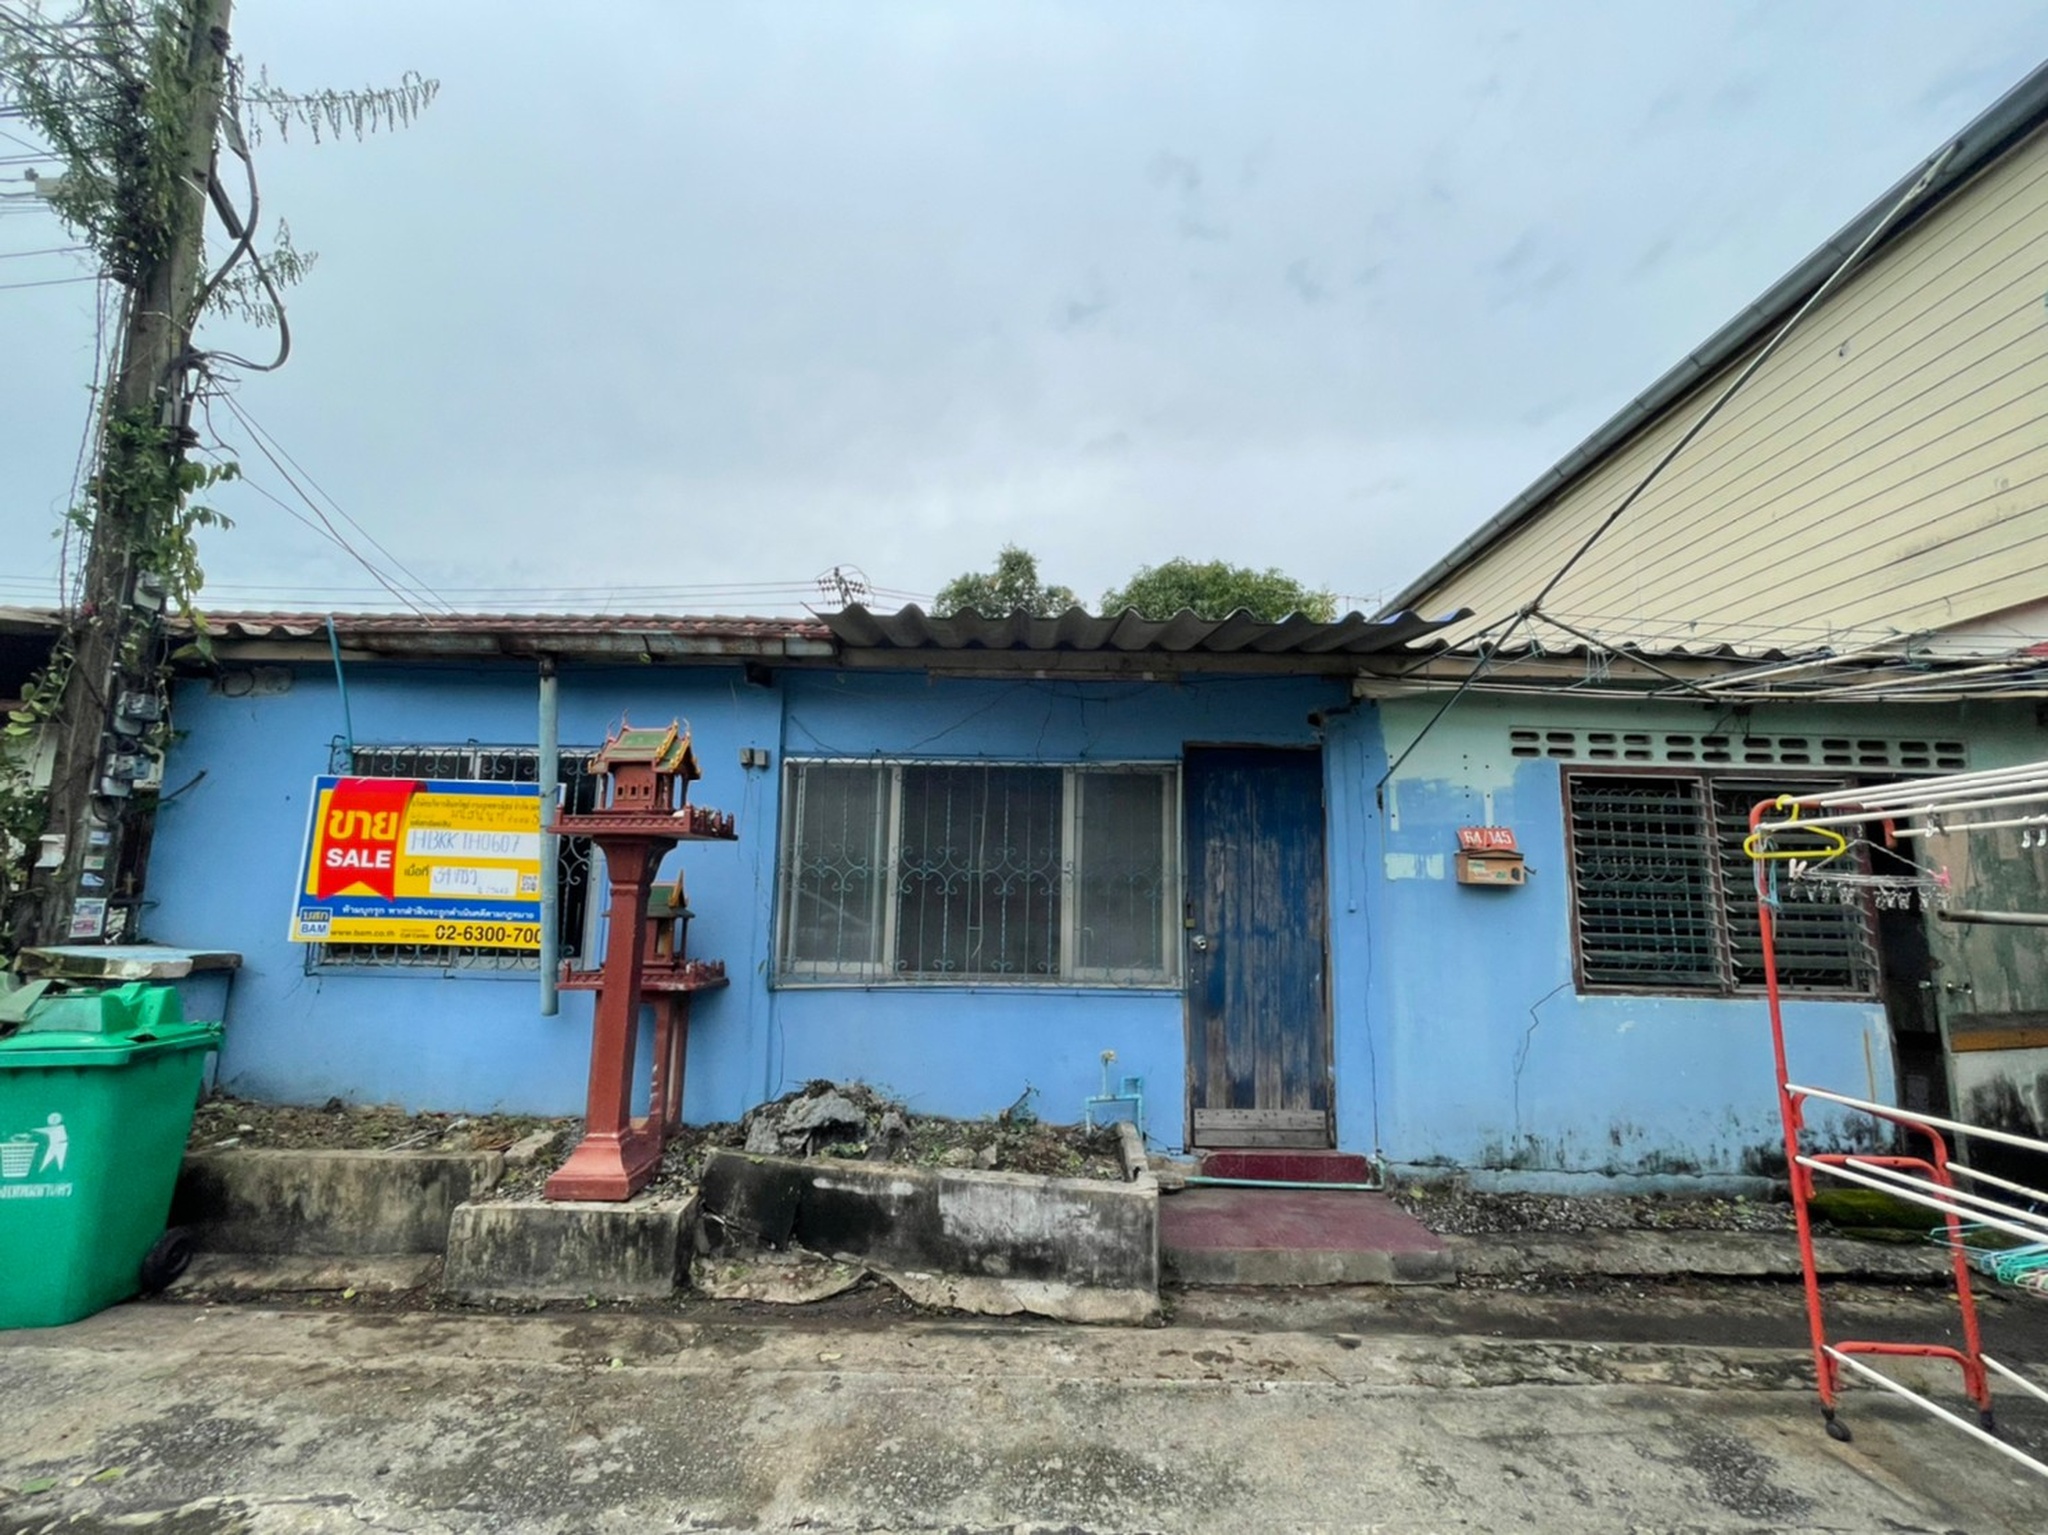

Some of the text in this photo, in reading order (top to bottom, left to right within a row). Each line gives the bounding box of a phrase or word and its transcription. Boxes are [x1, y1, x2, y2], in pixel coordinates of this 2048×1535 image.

[329, 809, 399, 841] ขาย
[1463, 829, 1512, 846] 64/145
[325, 847, 393, 869] SALE
[301, 923, 327, 933] BAM
